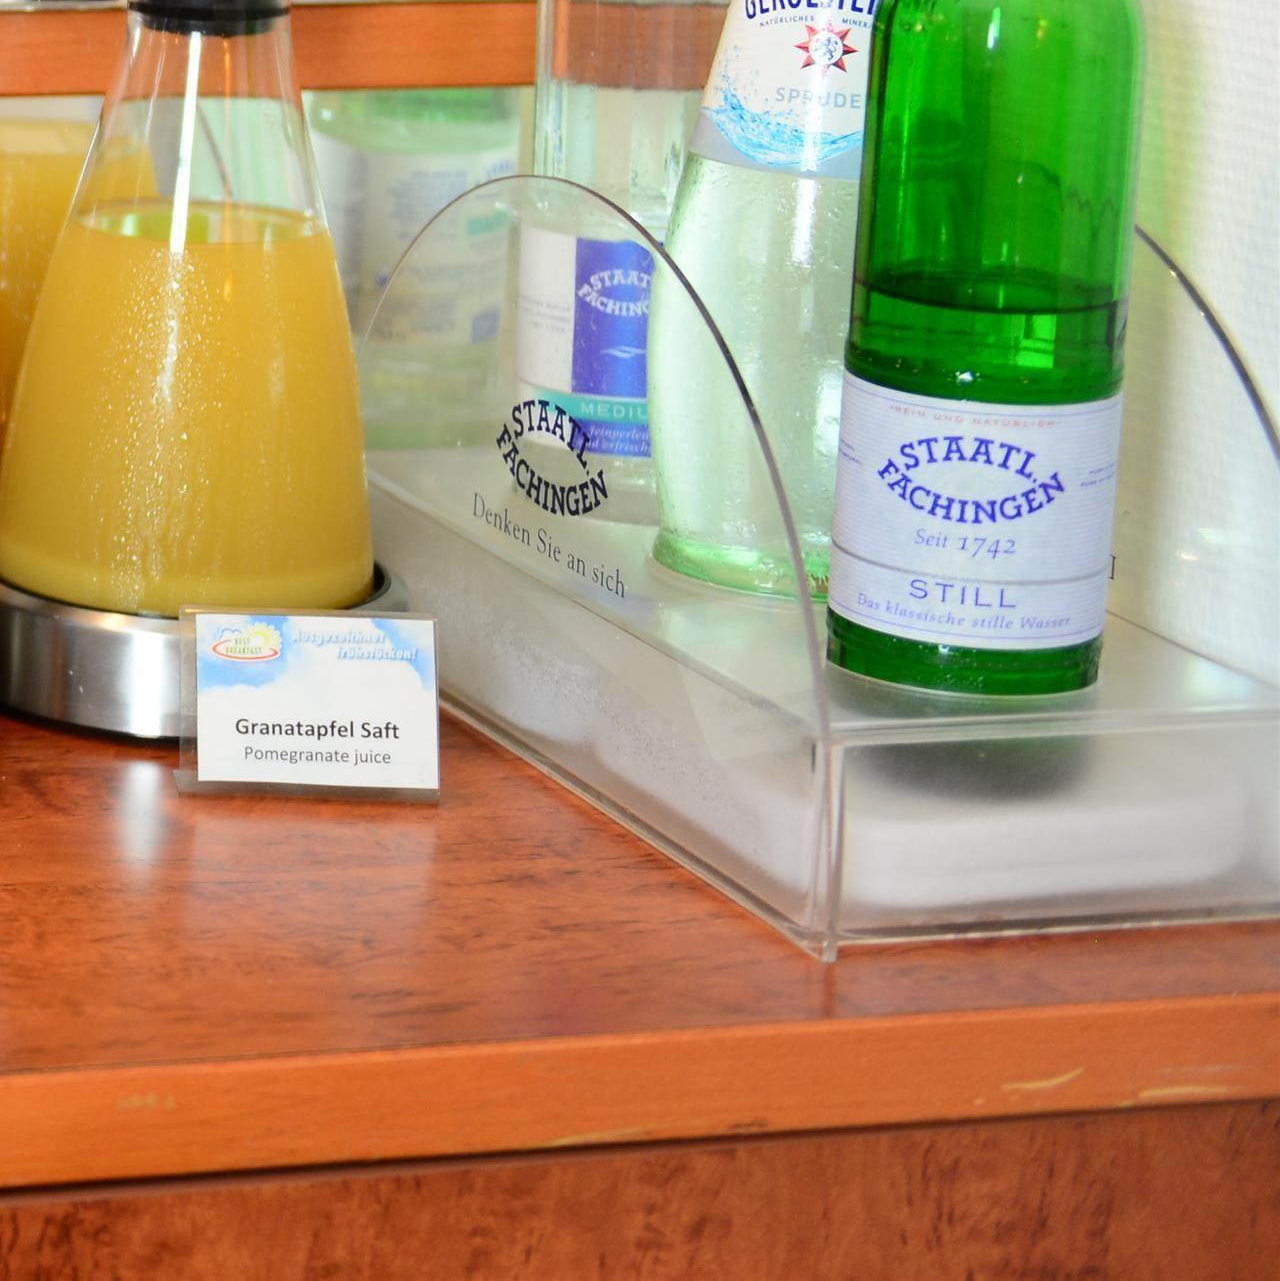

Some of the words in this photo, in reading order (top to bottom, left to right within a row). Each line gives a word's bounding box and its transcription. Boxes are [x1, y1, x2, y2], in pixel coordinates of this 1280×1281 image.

[759, 14, 815, 28] NATÜRLICHES
[512, 399, 590, 476] STAATL.
[496, 423, 608, 517] FACHINGEN
[900, 435, 1038, 483] STAATL.
[877, 458, 1065, 524] FACHINGEN
[472, 492, 531, 547] Denken
[536, 528, 562, 563] Sie
[567, 552, 586, 577] an
[591, 565, 625, 598] sich
[914, 527, 948, 549] Seit
[957, 536, 1017, 560] 1742
[857, 592, 881, 611] Das
[884, 598, 966, 627] klassische
[971, 614, 1014, 630] stille
[1019, 615, 1071, 631] Wasser
[908, 578, 1017, 609] STILL
[235, 718, 355, 741] Granatapfel
[360, 721, 400, 740] Saft
[243, 745, 351, 765] Pomegranate
[353, 749, 391, 767] juice
